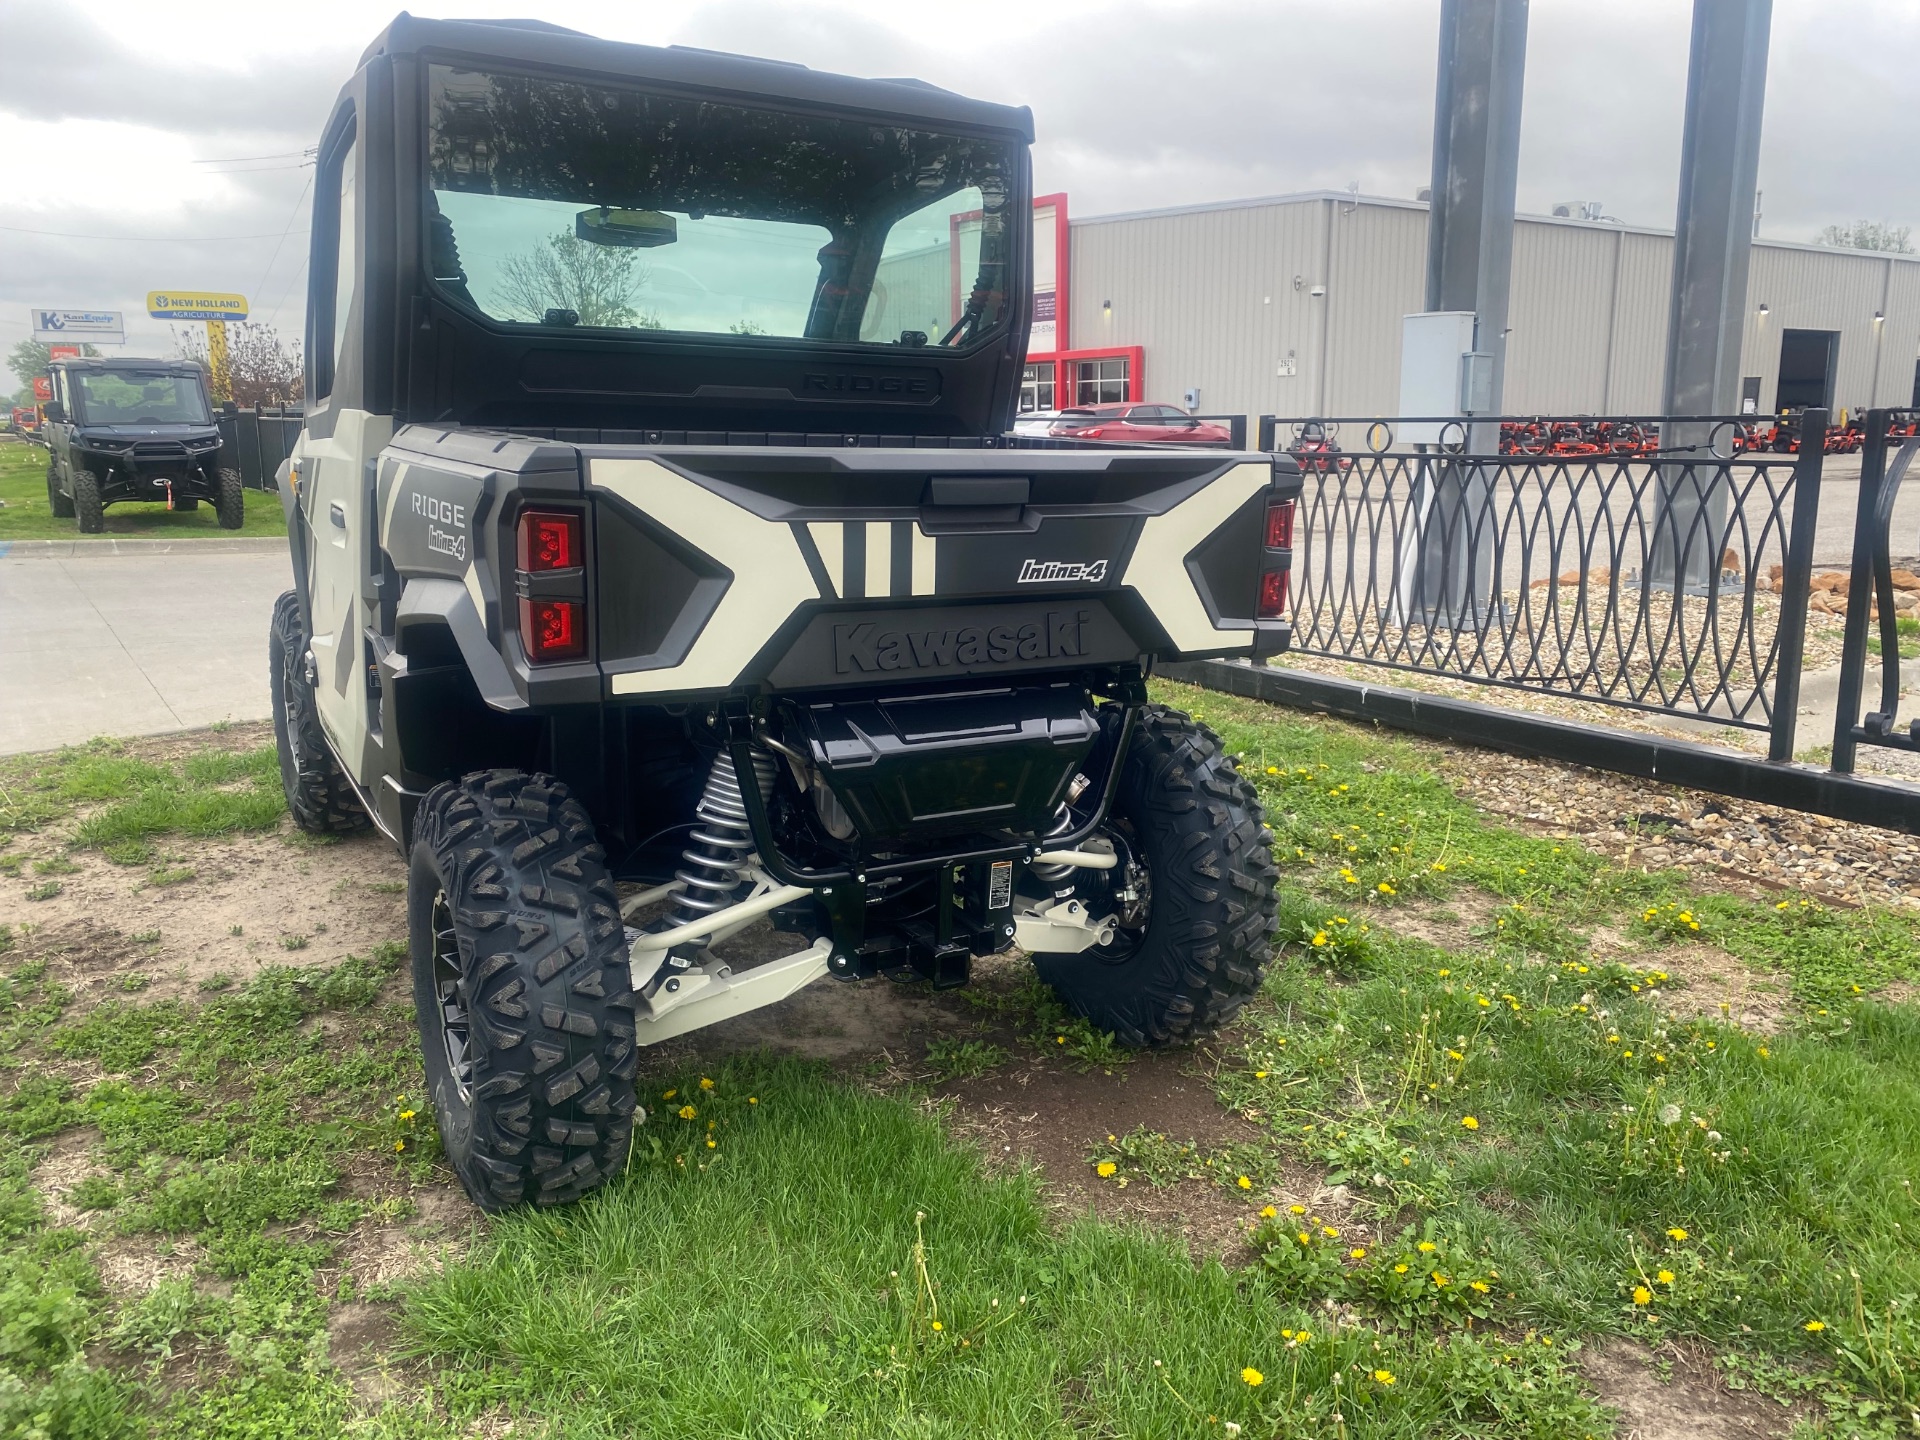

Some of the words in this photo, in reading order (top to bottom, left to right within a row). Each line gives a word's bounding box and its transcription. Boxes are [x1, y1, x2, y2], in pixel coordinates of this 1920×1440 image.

[171, 298, 193, 307] NEW
[195, 299, 240, 308] HOLLAND
[63, 313, 114, 323] KanEquip
[172, 311, 226, 319] AGRICULTURE
[801, 372, 928, 394] RIDGE
[411, 491, 466, 529] RIDGE
[1017, 558, 1109, 584] Inline-4
[833, 609, 1091, 675] Kawasaki
